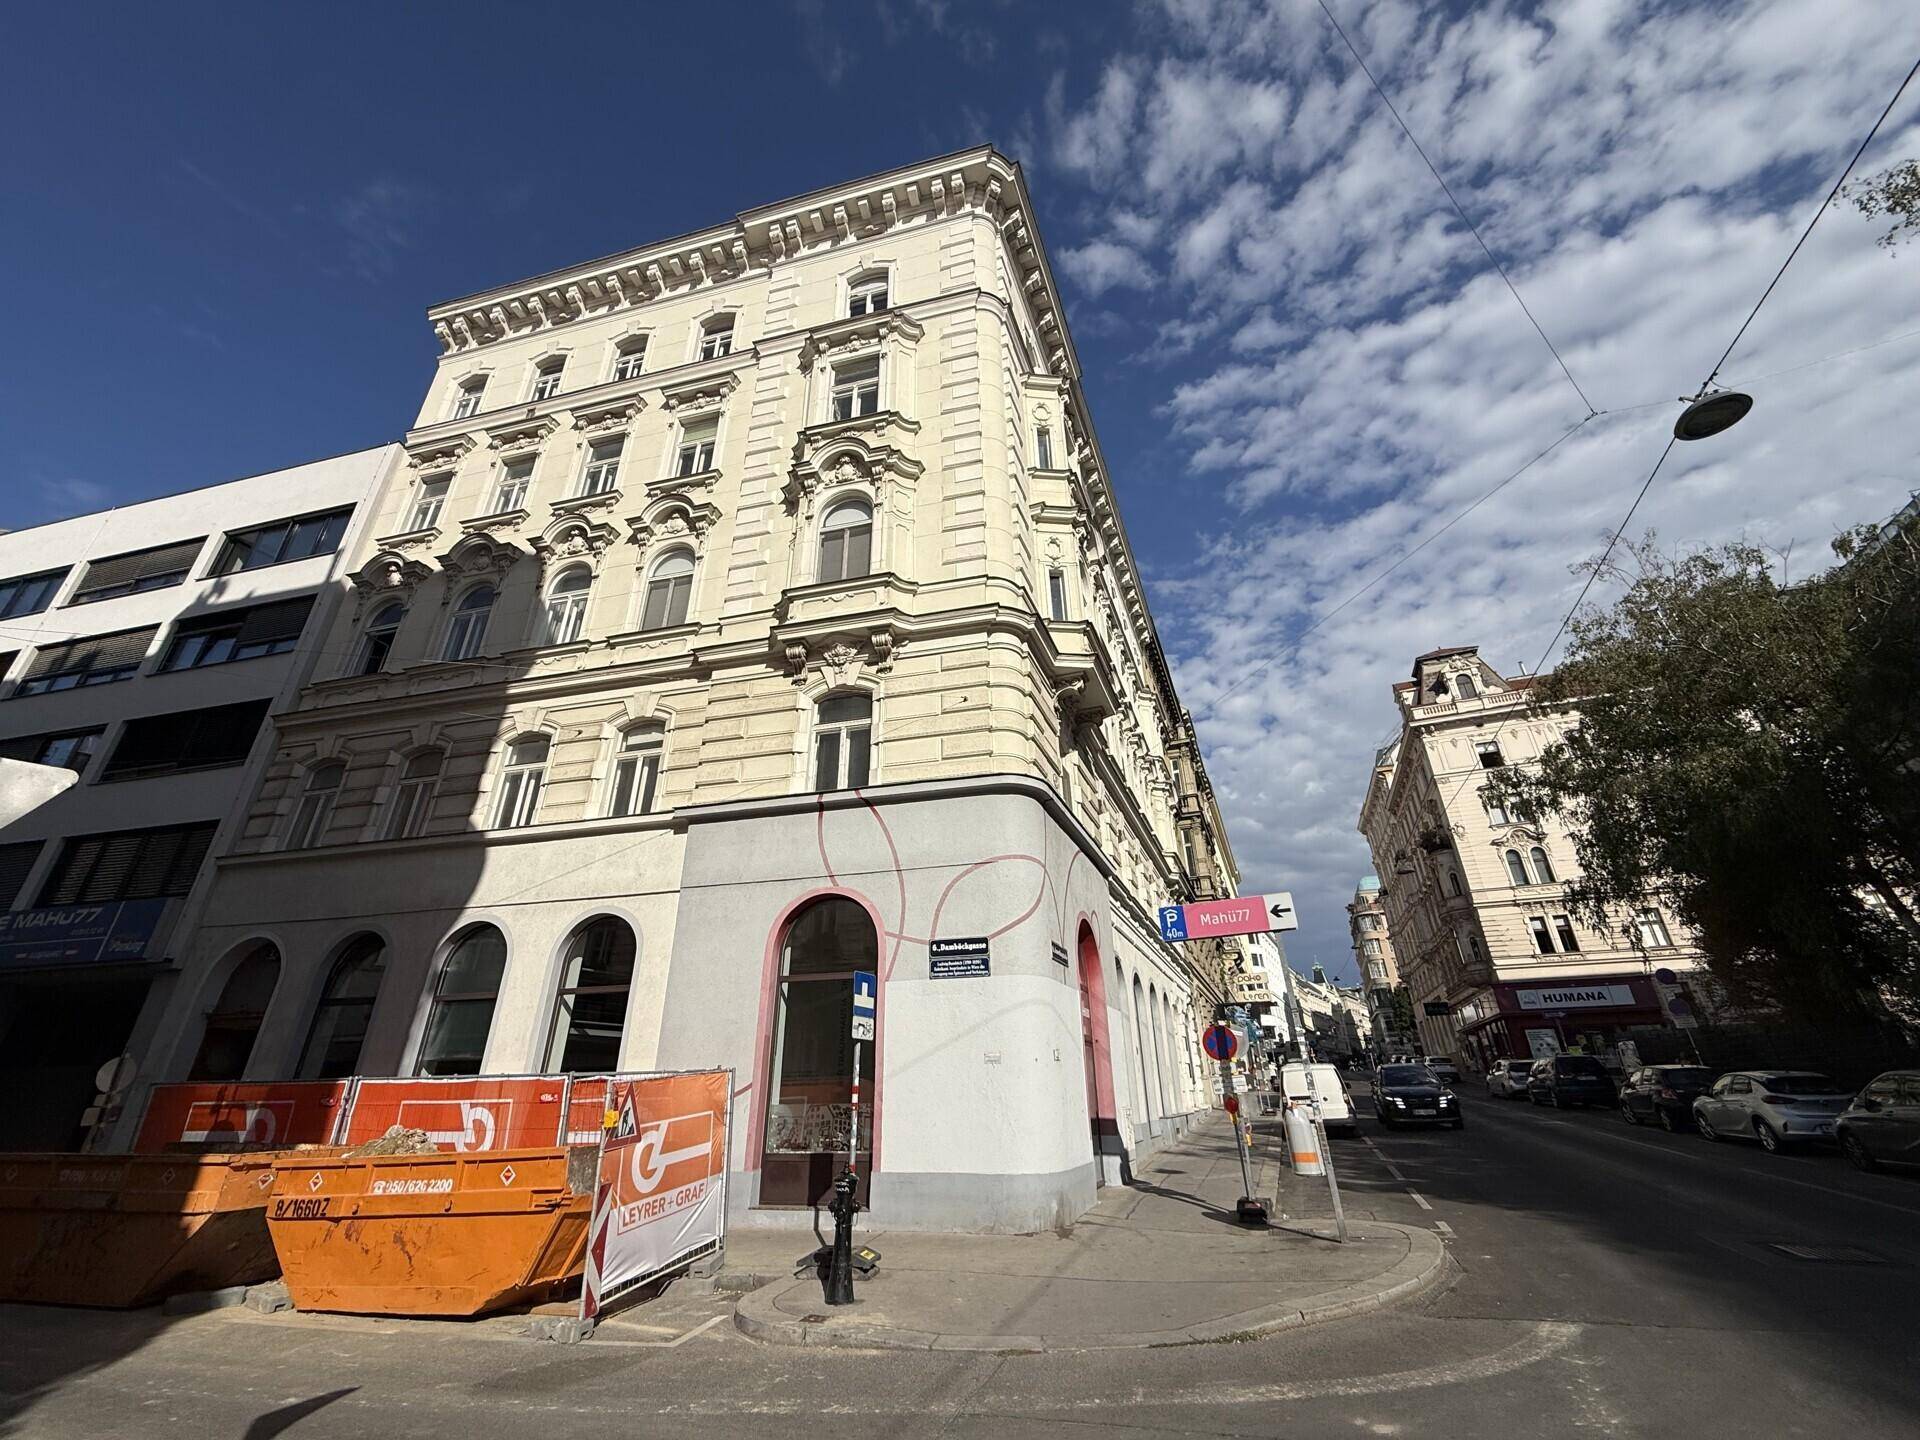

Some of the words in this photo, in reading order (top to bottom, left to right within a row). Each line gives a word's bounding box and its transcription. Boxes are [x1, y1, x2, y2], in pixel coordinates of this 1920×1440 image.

[1166, 913, 1178, 928] P
[1200, 909, 1250, 926] Mahü77
[1166, 927, 1184, 939] 40m
[1542, 991, 1607, 1003] HUMANA
[622, 1196, 666, 1227] LEYRER
[675, 1182, 705, 1207] GRAF
